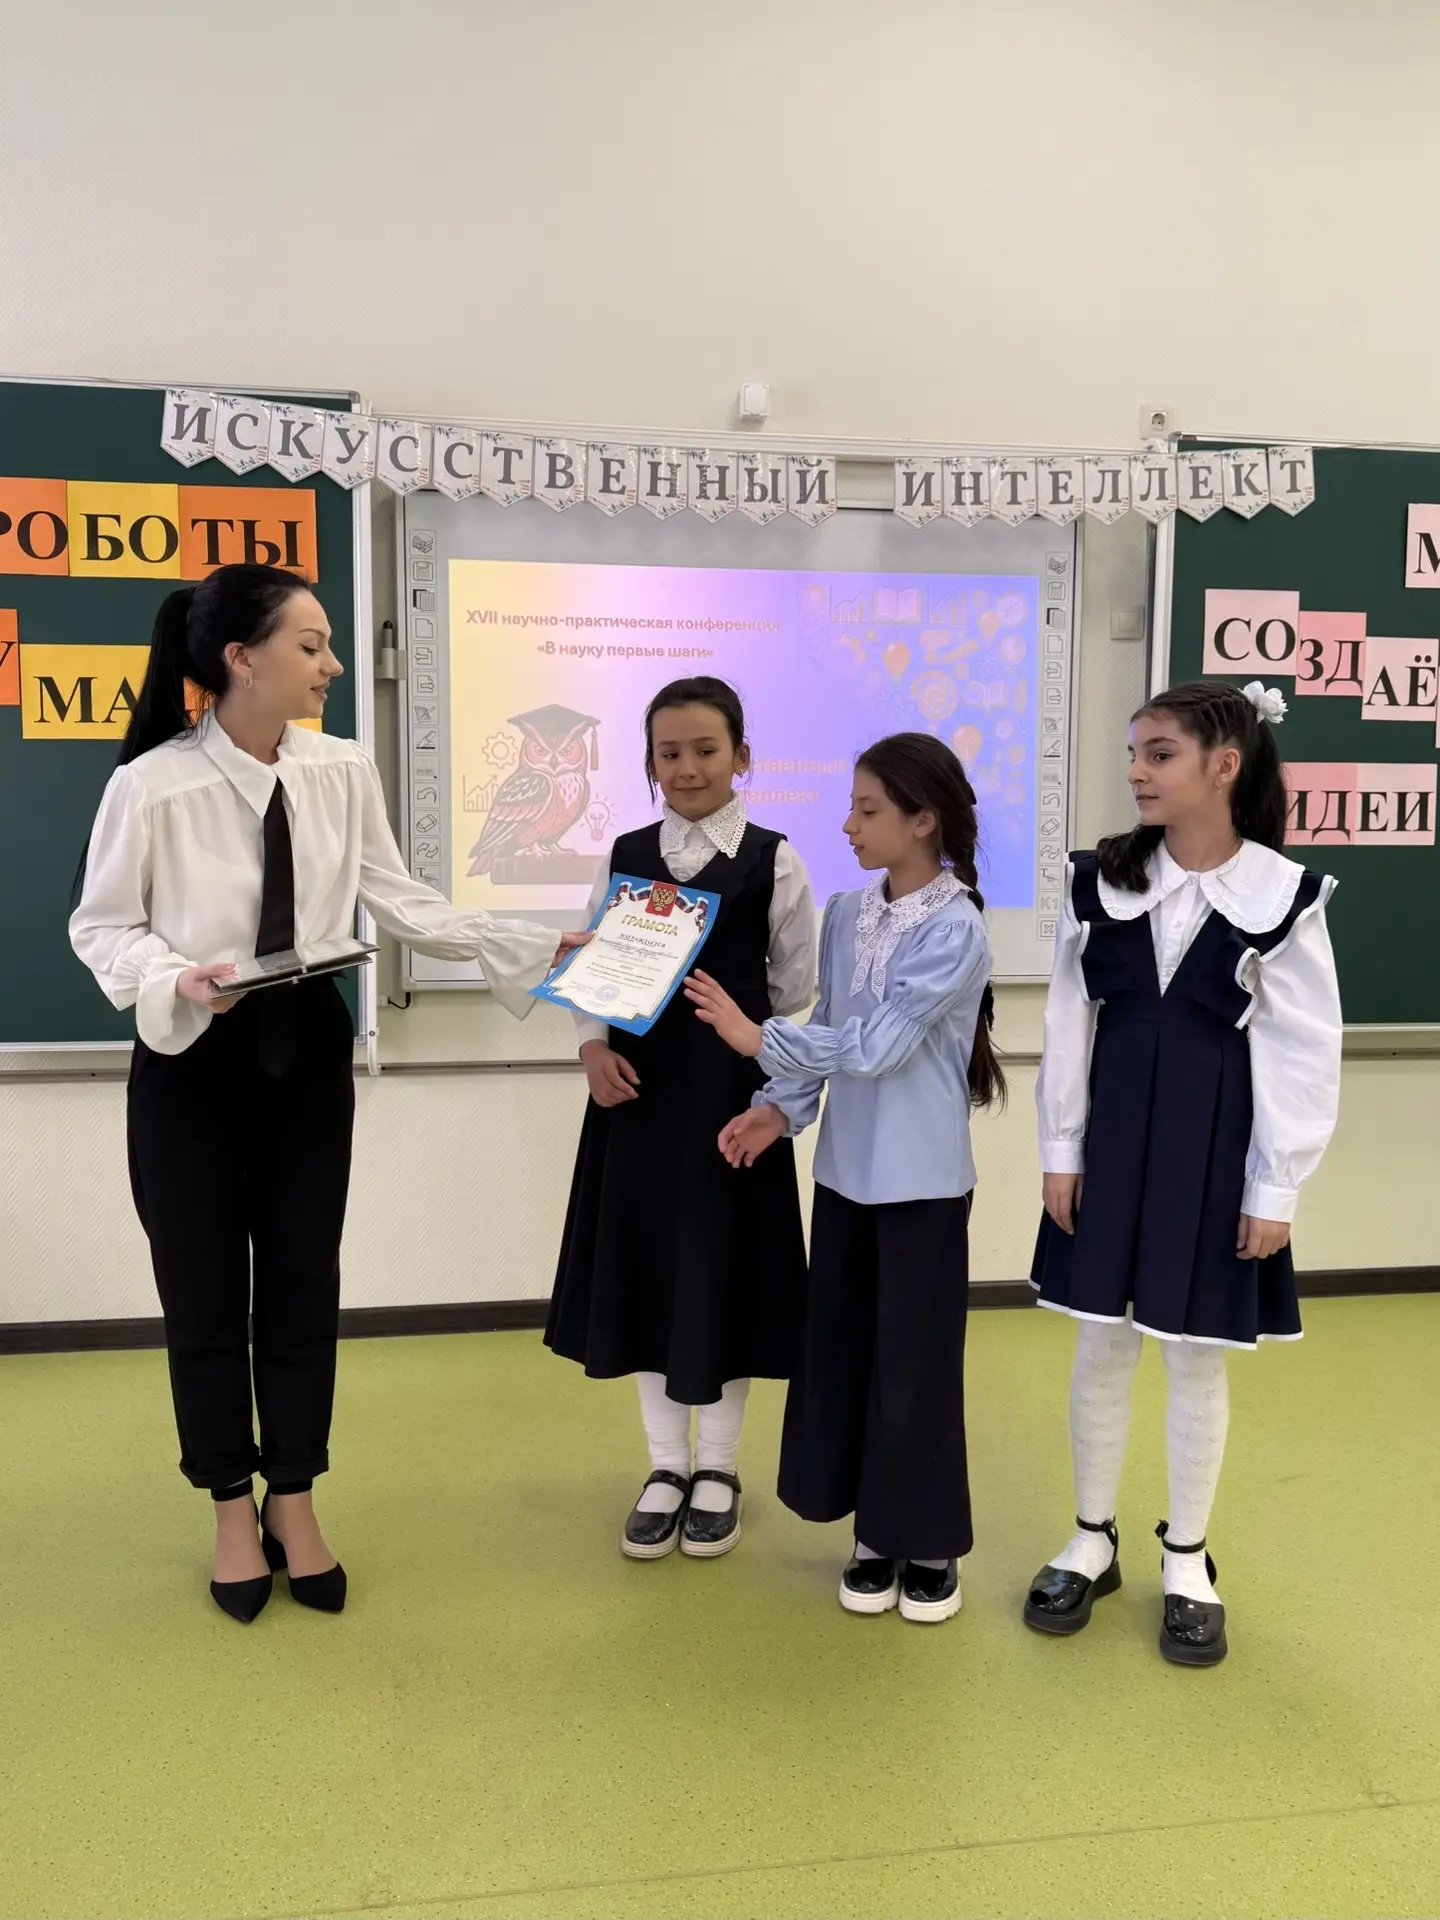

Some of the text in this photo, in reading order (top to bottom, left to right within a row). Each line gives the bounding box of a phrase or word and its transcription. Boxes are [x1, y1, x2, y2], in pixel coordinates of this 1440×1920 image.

[170, 403, 1306, 506] ИСКУССТВЕННЫЙ ИНТЕЛЛЕКТ
[466, 610, 781, 633] XVII научно-практическая конференция
[537, 640, 714, 660] «В науку первые шаги»
[621, 914, 678, 936] ГРАМОТА
